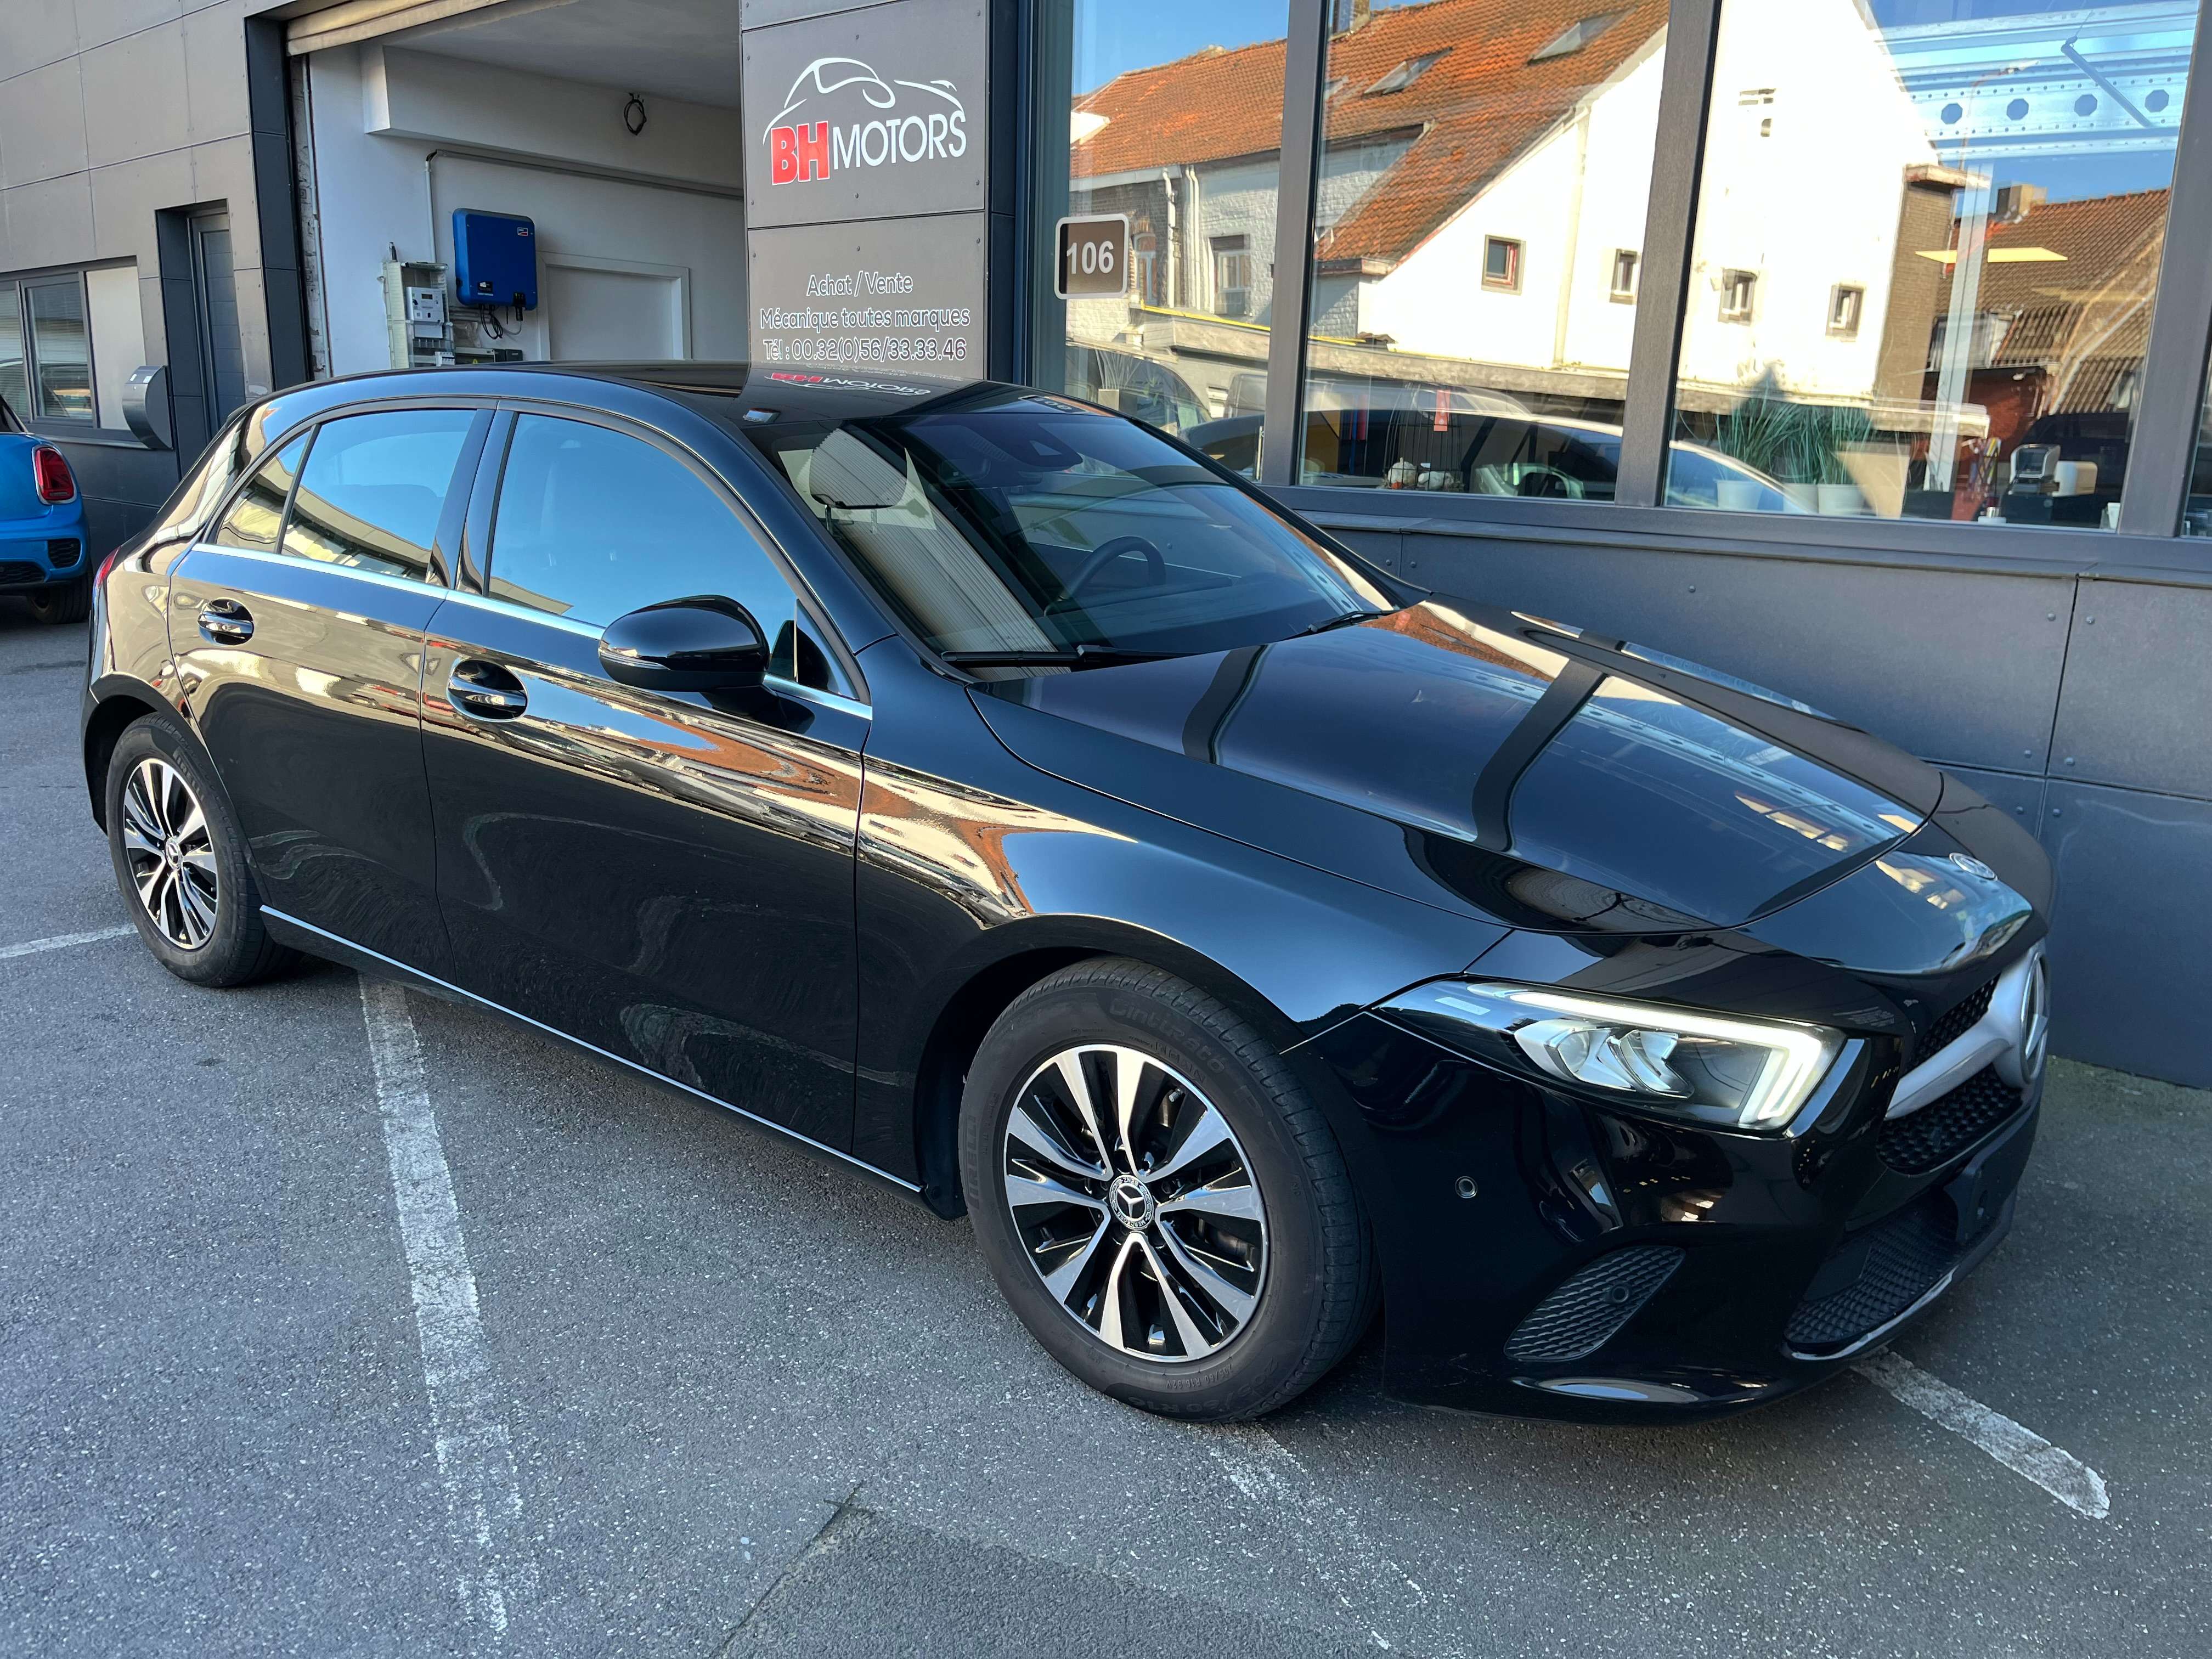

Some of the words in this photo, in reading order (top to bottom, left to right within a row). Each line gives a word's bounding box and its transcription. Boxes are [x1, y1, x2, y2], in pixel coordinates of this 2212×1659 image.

[1066, 241, 1114, 274] 106
[806, 274, 852, 297] Achat
[865, 272, 913, 295] Vente
[760, 307, 838, 334] Mécanique
[842, 307, 891, 328] toutes
[895, 307, 970, 332] marques
[1109, 997, 1226, 1074] Cinturato
[1122, 1176, 1139, 1186] BENZ
